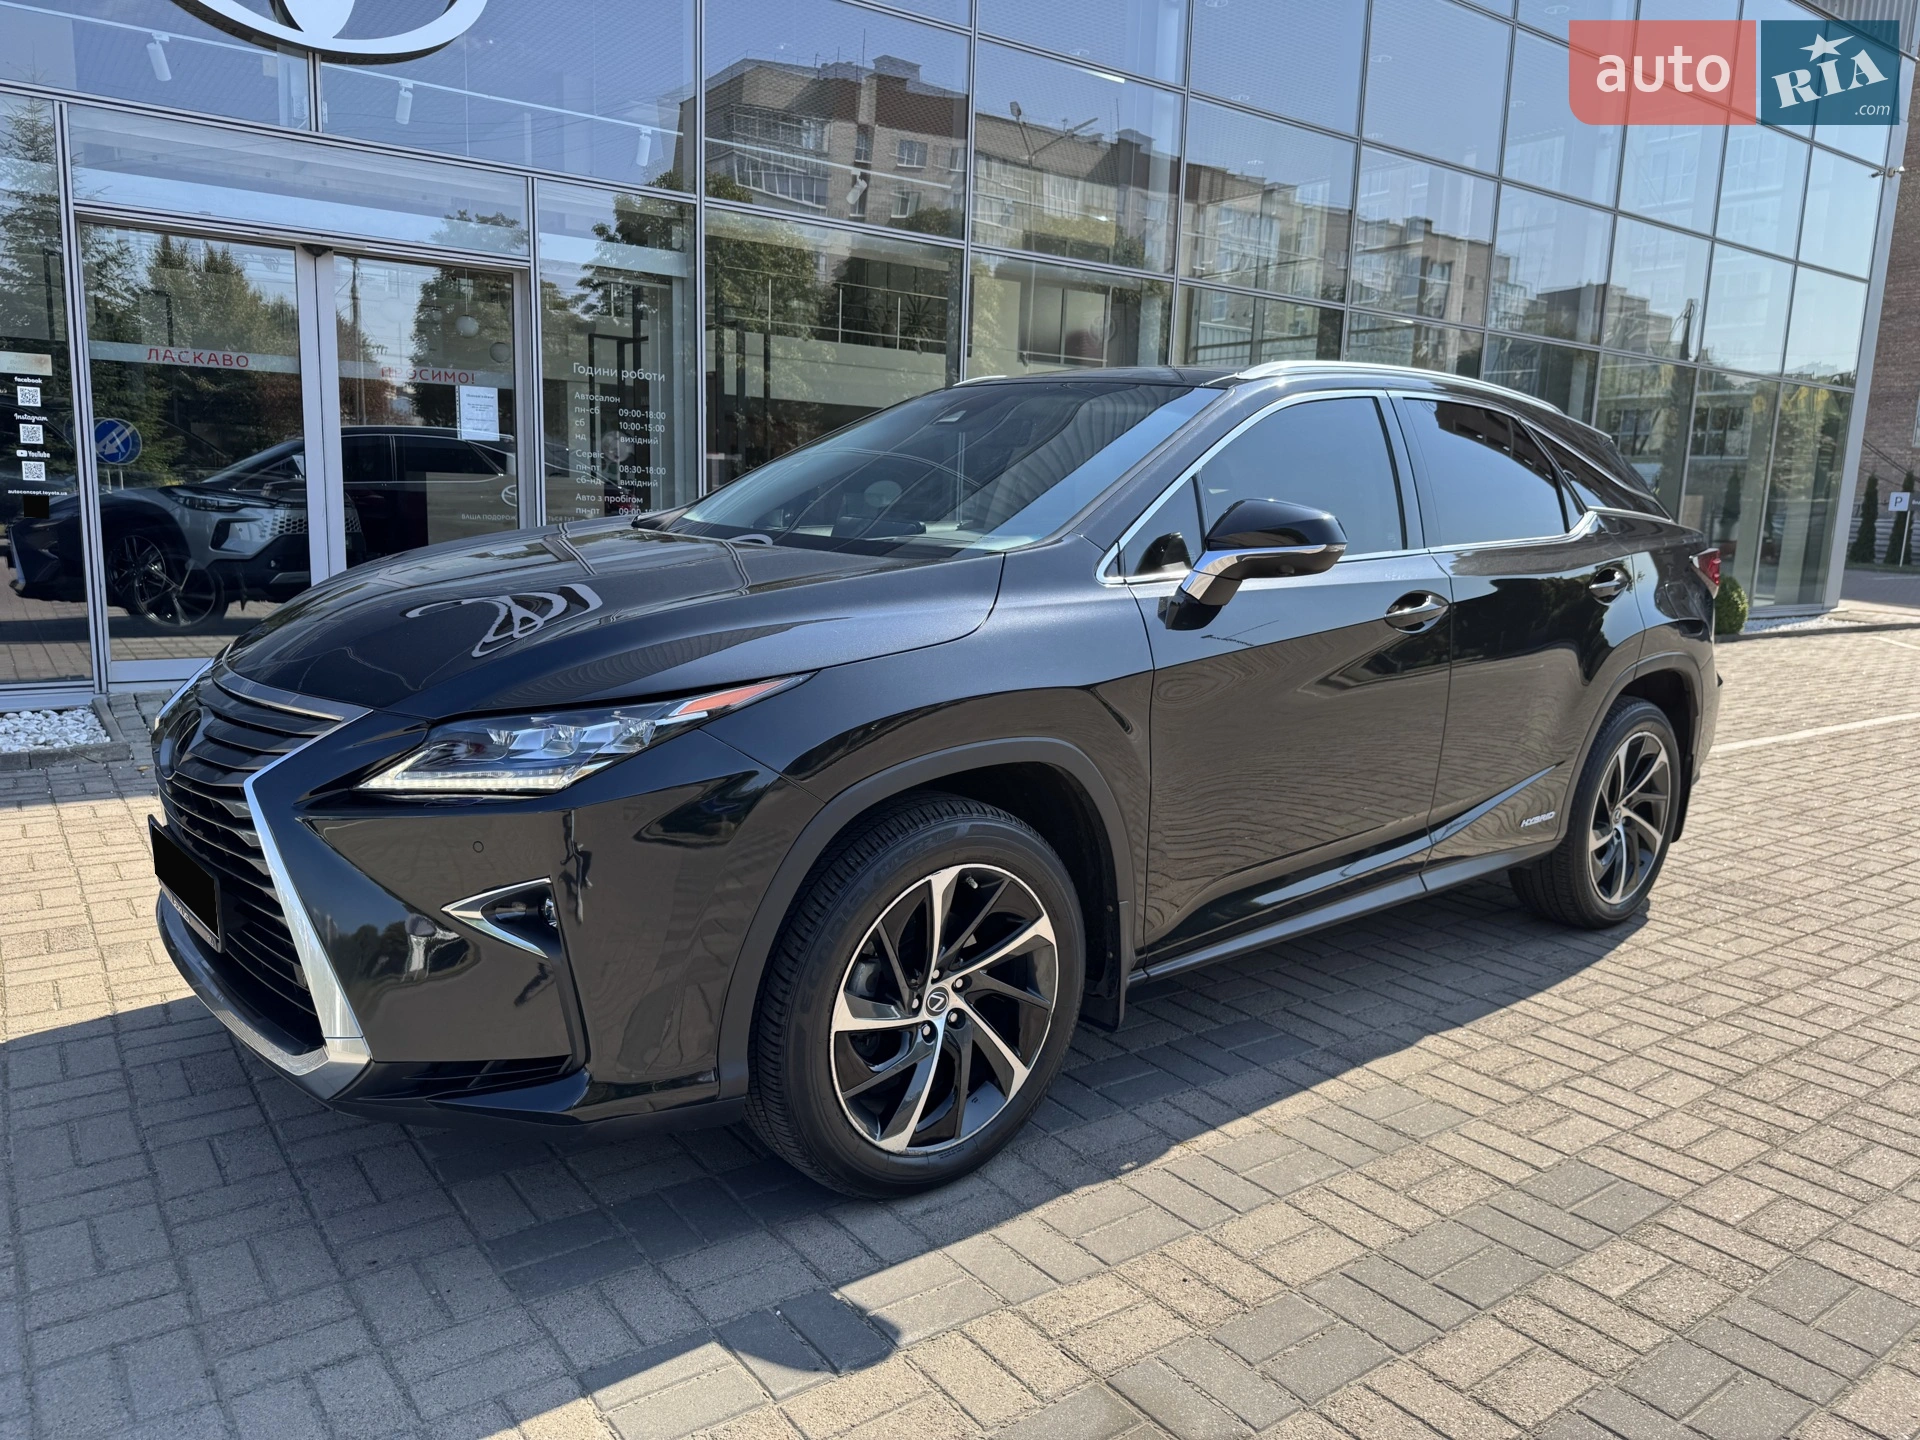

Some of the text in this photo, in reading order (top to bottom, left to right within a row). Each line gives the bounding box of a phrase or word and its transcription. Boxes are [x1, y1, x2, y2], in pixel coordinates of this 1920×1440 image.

[147, 348, 249, 368] ЛАСКАВО
[573, 362, 665, 382] Години роботи
[14, 376, 43, 384] facebook
[574, 391, 621, 403] Автосалон
[14, 412, 48, 423] Instagram
[574, 406, 666, 420] пн-сб 09:00-18:00
[574, 418, 665, 433] сб 10:00-15:00
[575, 433, 659, 445] нд вихідний
[28, 450, 50, 458] YouTube
[575, 449, 604, 459] Сервіс
[575, 464, 666, 475] пн-пт 08:30-18:00
[576, 475, 659, 488] сб-нд вихідний
[575, 493, 644, 504] Авто з пробігом
[1894, 496, 1903, 507] P
[1520, 811, 1556, 828] HYBRID
